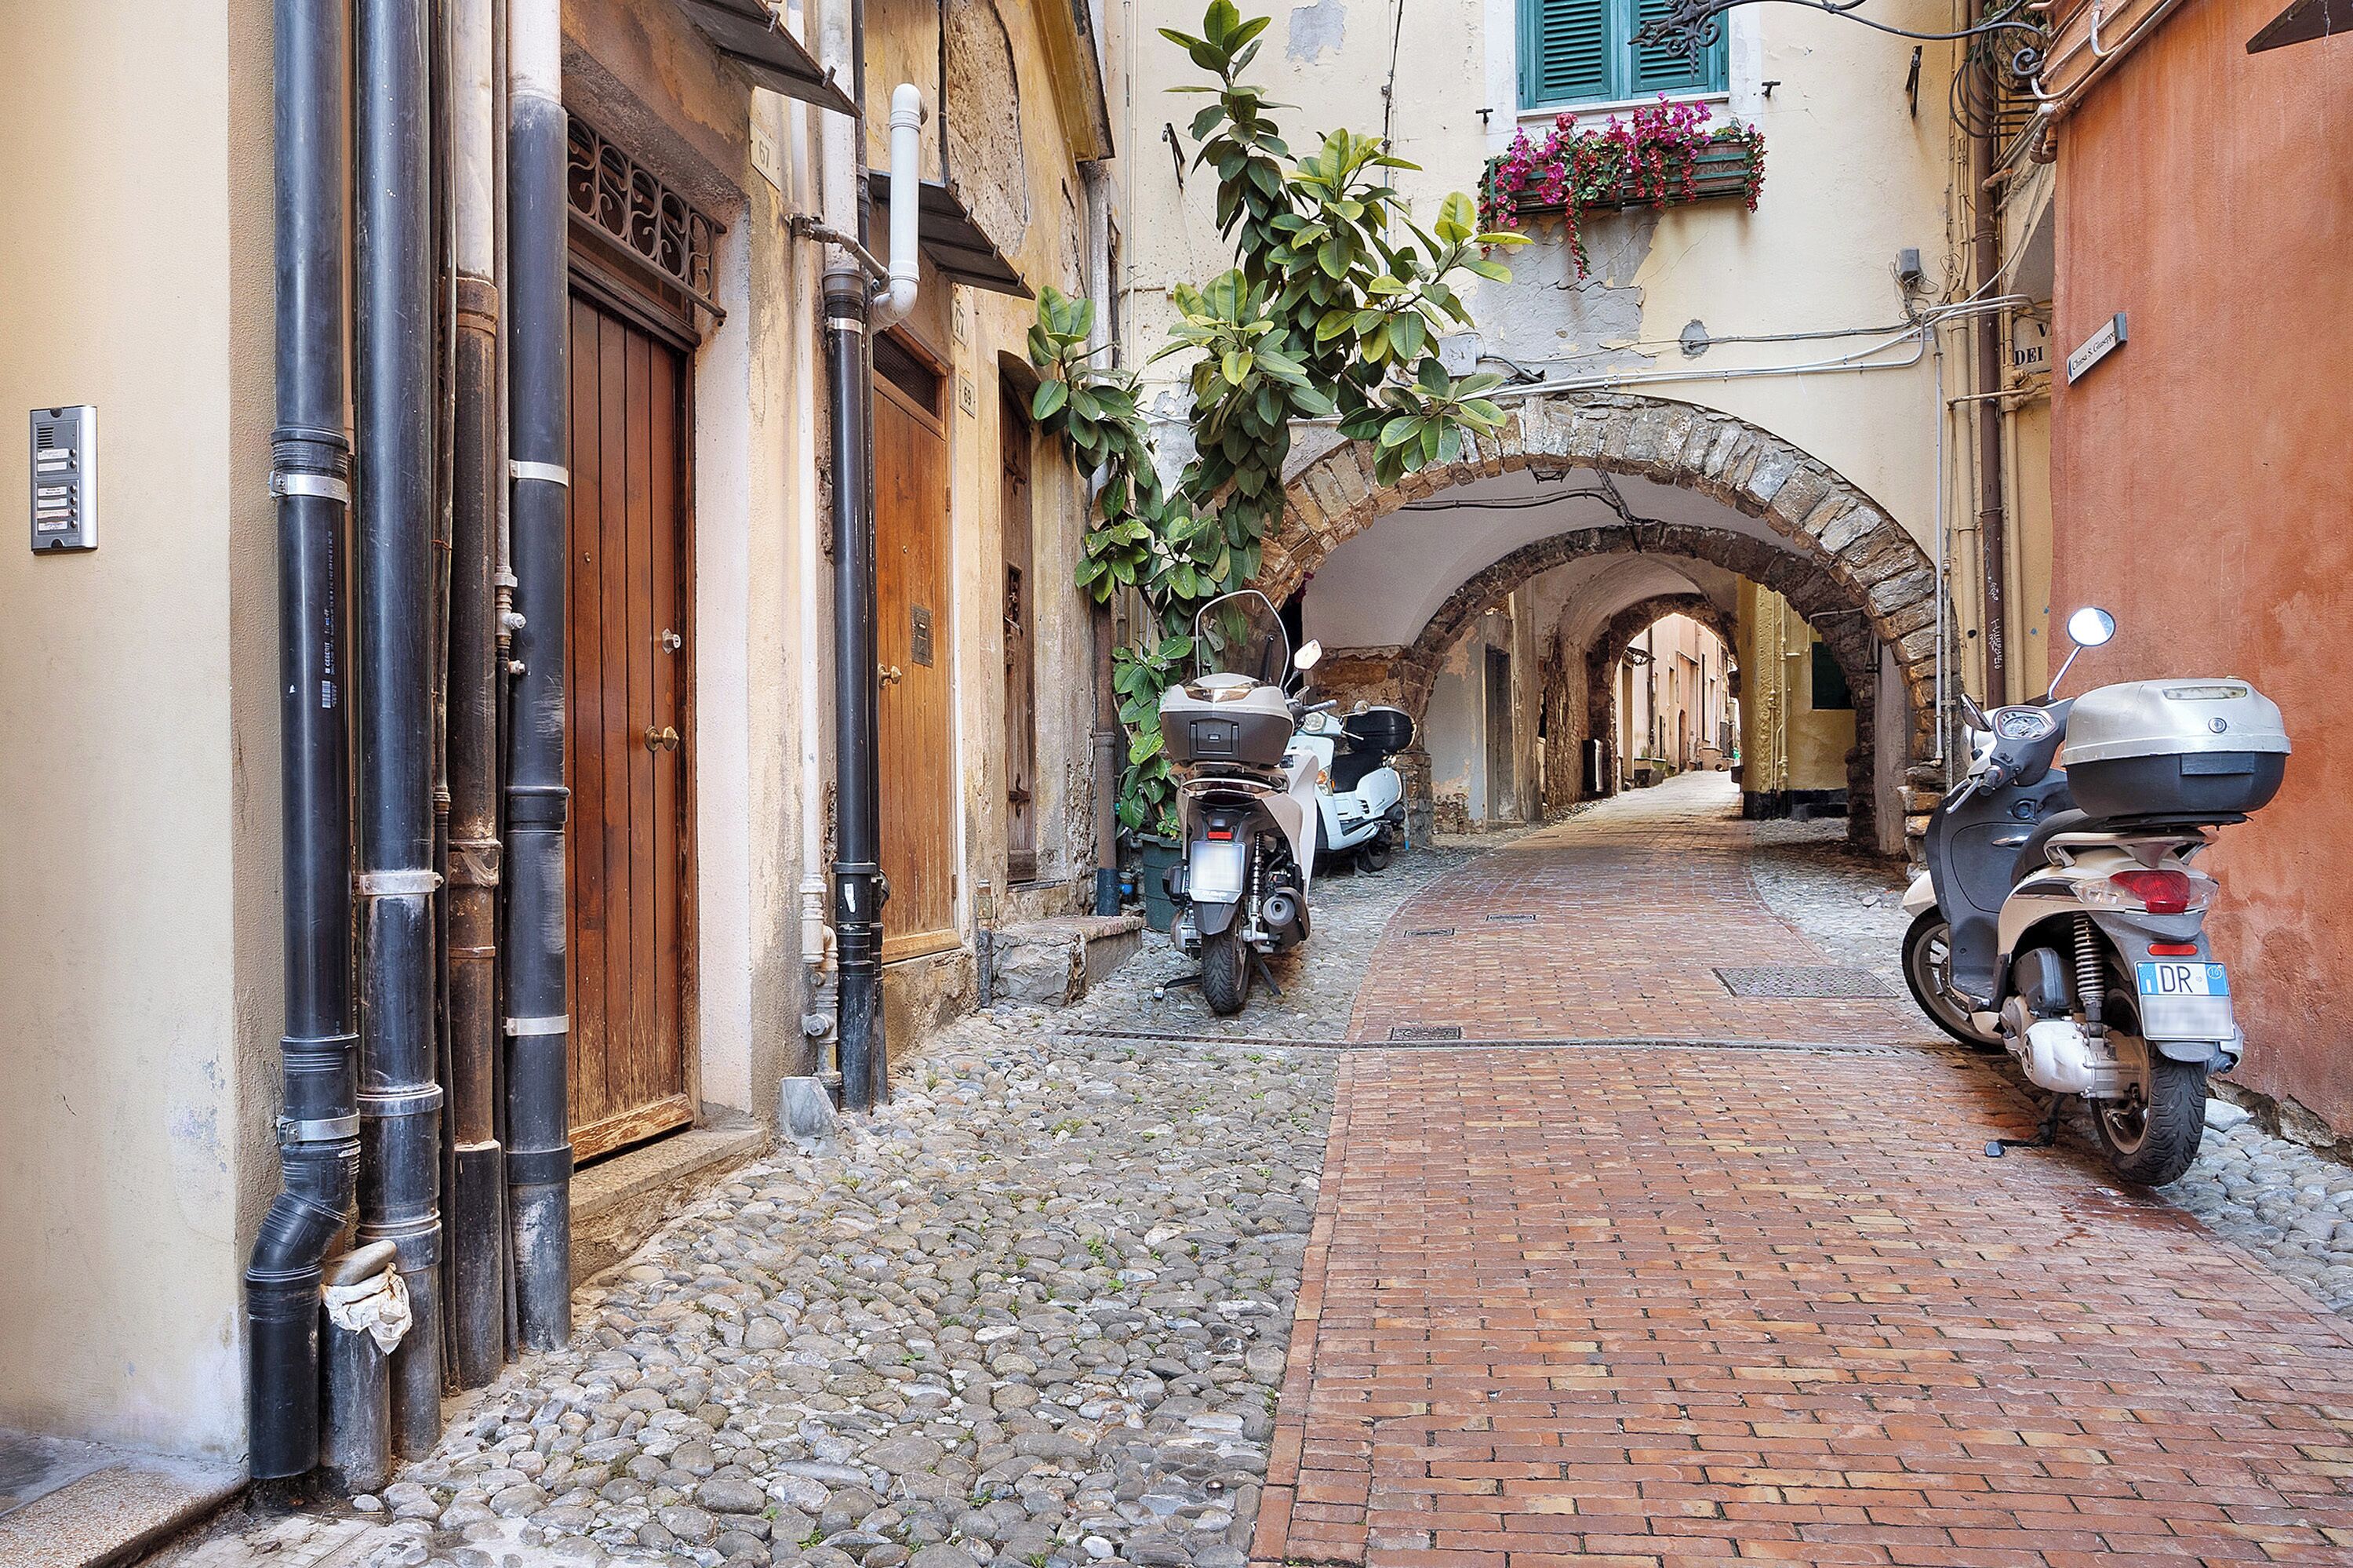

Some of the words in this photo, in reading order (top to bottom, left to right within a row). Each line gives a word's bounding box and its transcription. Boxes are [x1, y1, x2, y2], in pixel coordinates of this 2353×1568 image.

[758, 140, 770, 169] 67
[2014, 346, 2043, 366] DEI
[2072, 355, 2088, 370] Chiesa
[2159, 965, 2193, 993] DR
